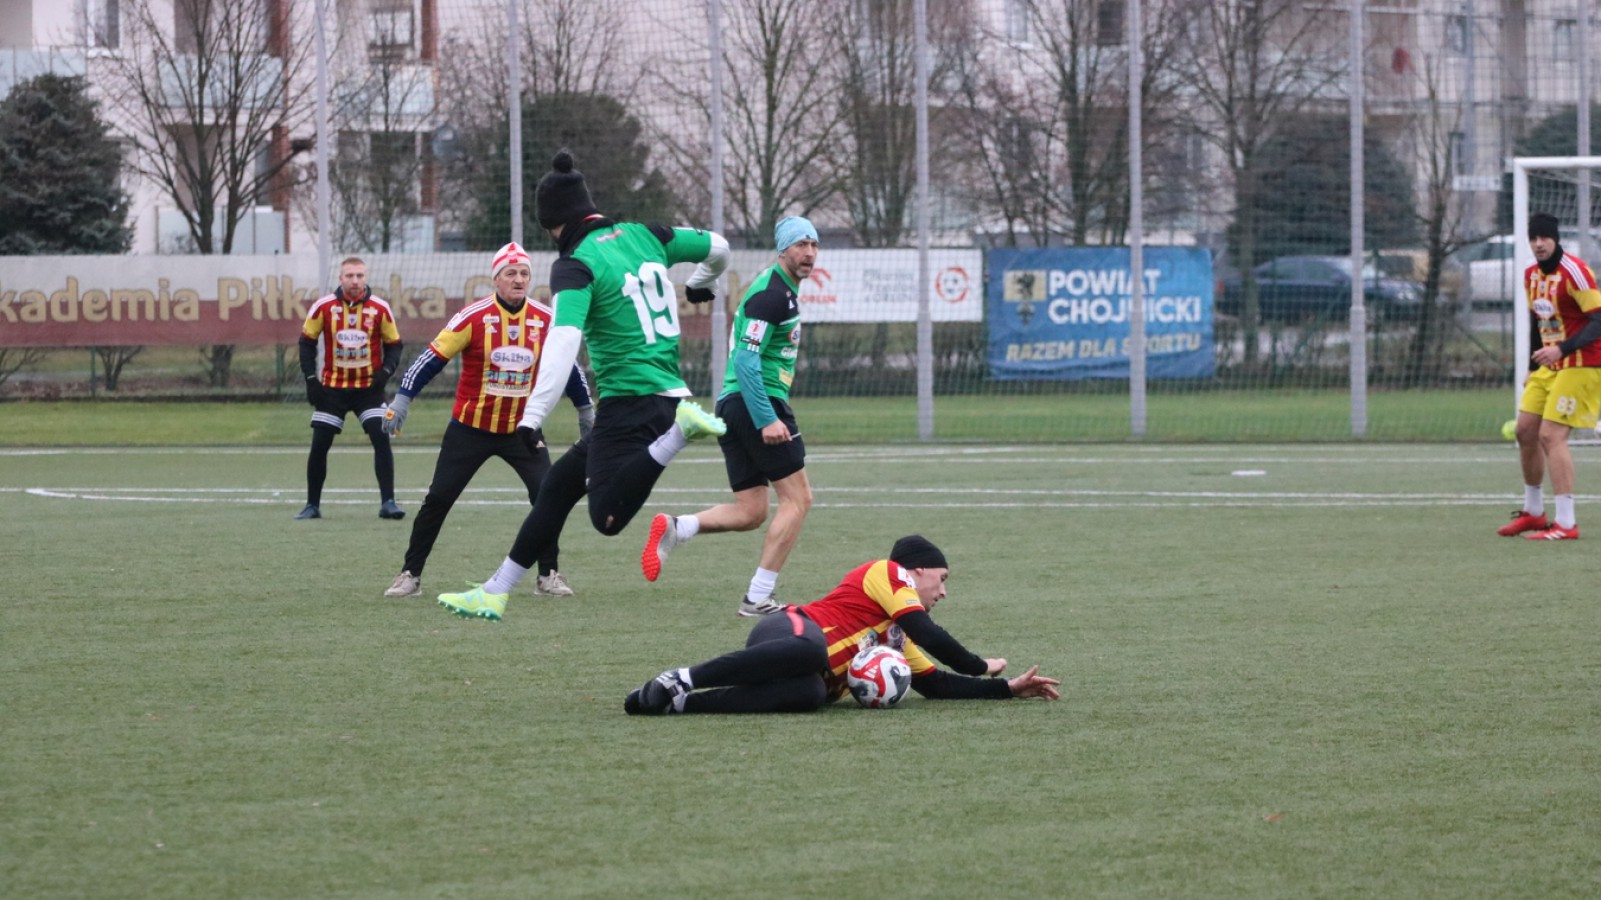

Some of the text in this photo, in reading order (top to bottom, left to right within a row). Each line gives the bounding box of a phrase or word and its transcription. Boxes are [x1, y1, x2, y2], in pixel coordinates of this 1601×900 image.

[622, 261, 681, 344] 19
[493, 351, 531, 363] Skiba
[1006, 332, 1202, 361] RAZEM DLA SORTU
[1556, 396, 1576, 416] 83
